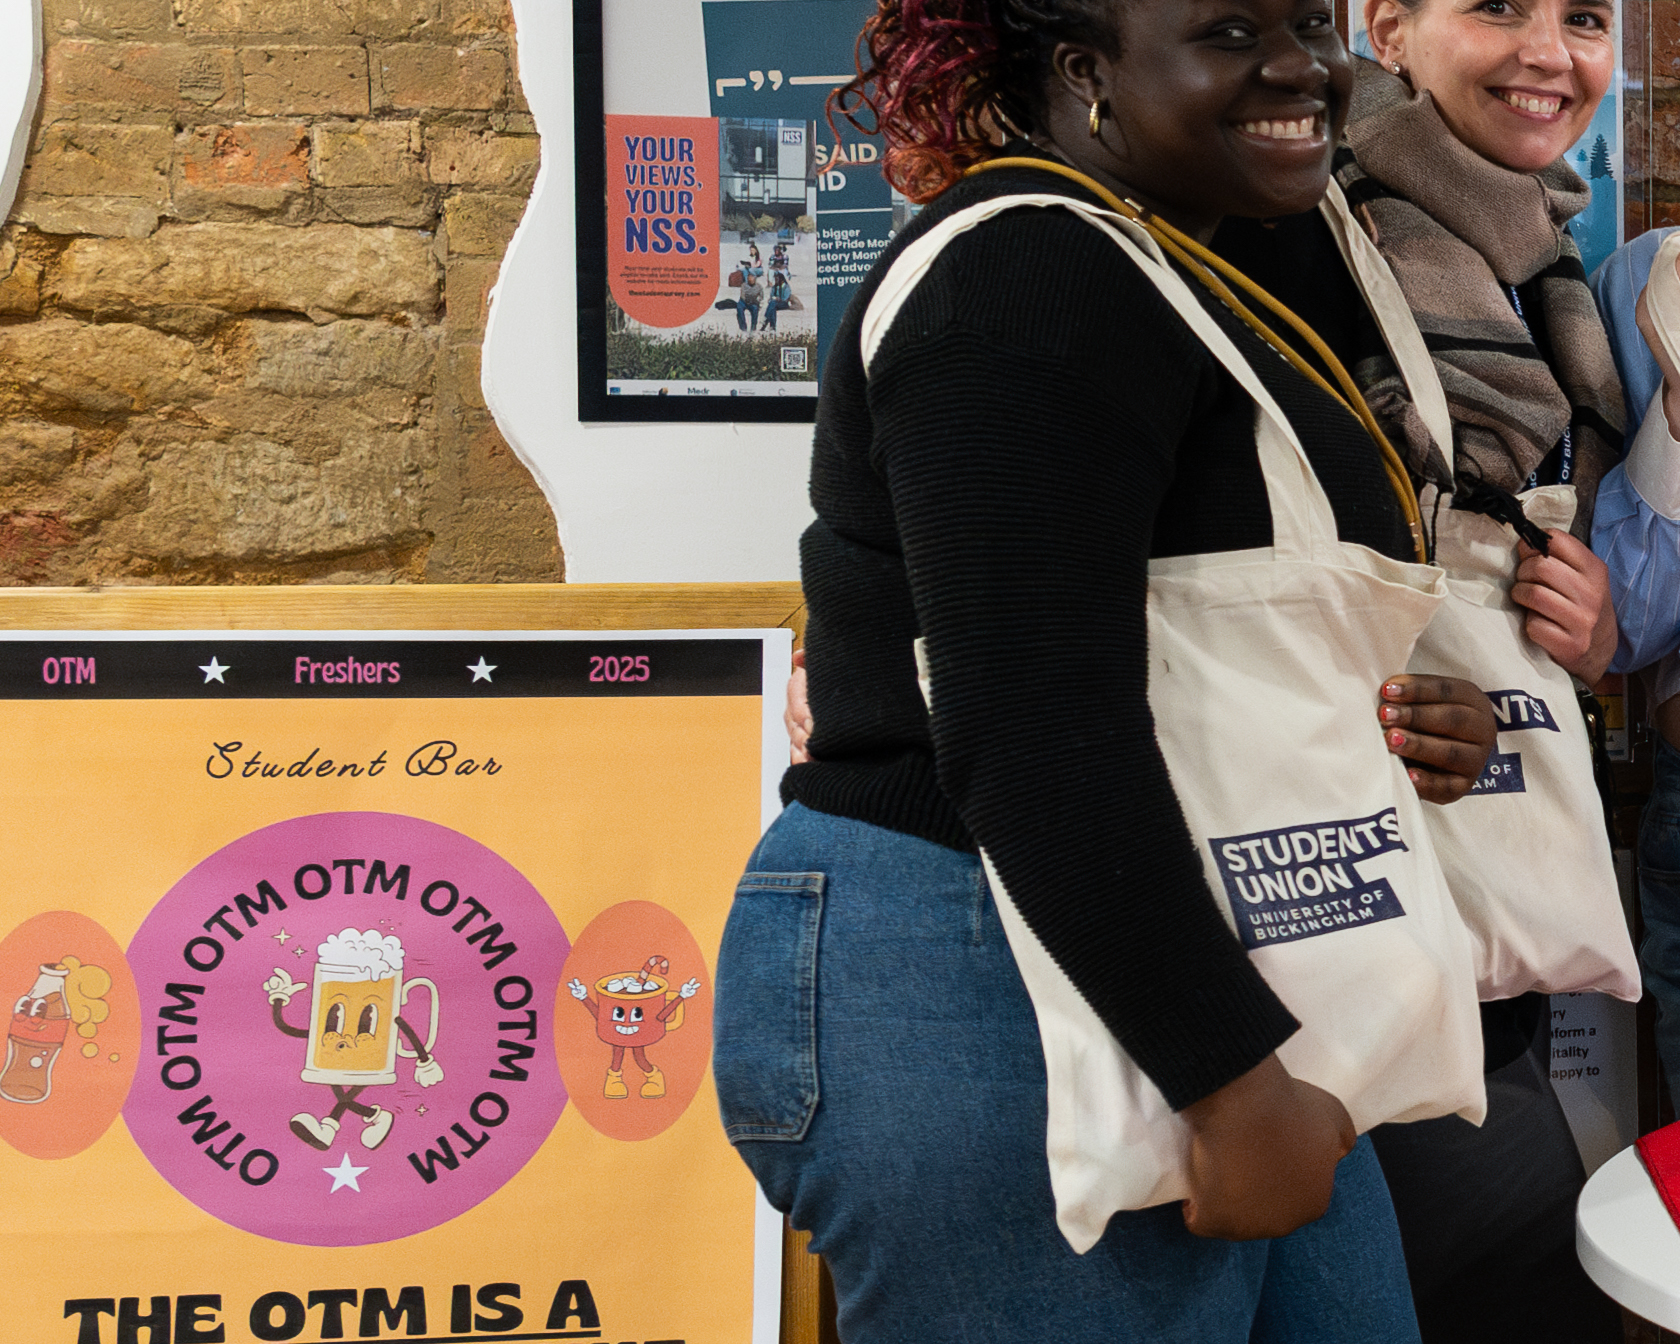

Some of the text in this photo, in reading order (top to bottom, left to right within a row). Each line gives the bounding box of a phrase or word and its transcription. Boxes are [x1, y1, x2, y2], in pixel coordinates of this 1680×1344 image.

[624, 136, 694, 163] YOUR
[783, 131, 802, 144] NSS
[815, 143, 878, 165] SAID
[625, 164, 703, 191] VIEWS,
[625, 189, 695, 215] YOUR
[625, 217, 708, 254] NSS.
[817, 238, 891, 250] for Pride Mon
[823, 228, 860, 242] bigger
[817, 250, 884, 262] istory Mont
[837, 275, 864, 287] grou
[42, 657, 97, 685] OTM
[294, 656, 401, 685] Freshers
[588, 655, 651, 684] 2025
[204, 739, 504, 781] Student Bar
[293, 858, 411, 902] OTM
[1233, 861, 1354, 905] UNION
[1248, 888, 1386, 927] UNIVERSITY OF
[183, 879, 288, 974] OTM
[419, 879, 520, 970] OTM
[1254, 906, 1376, 942] BUCKINGHAM
[156, 983, 207, 1091] OTM
[493, 974, 539, 1083] OTM
[1589, 1027, 1597, 1037] a
[1552, 1045, 1590, 1060] itality
[1551, 1065, 1600, 1081] appy to
[177, 1092, 281, 1187] OTM
[408, 1094, 510, 1186] OTM
[249, 1285, 428, 1343] OTM
[450, 1282, 525, 1334] IS
[544, 1279, 601, 1332] A
